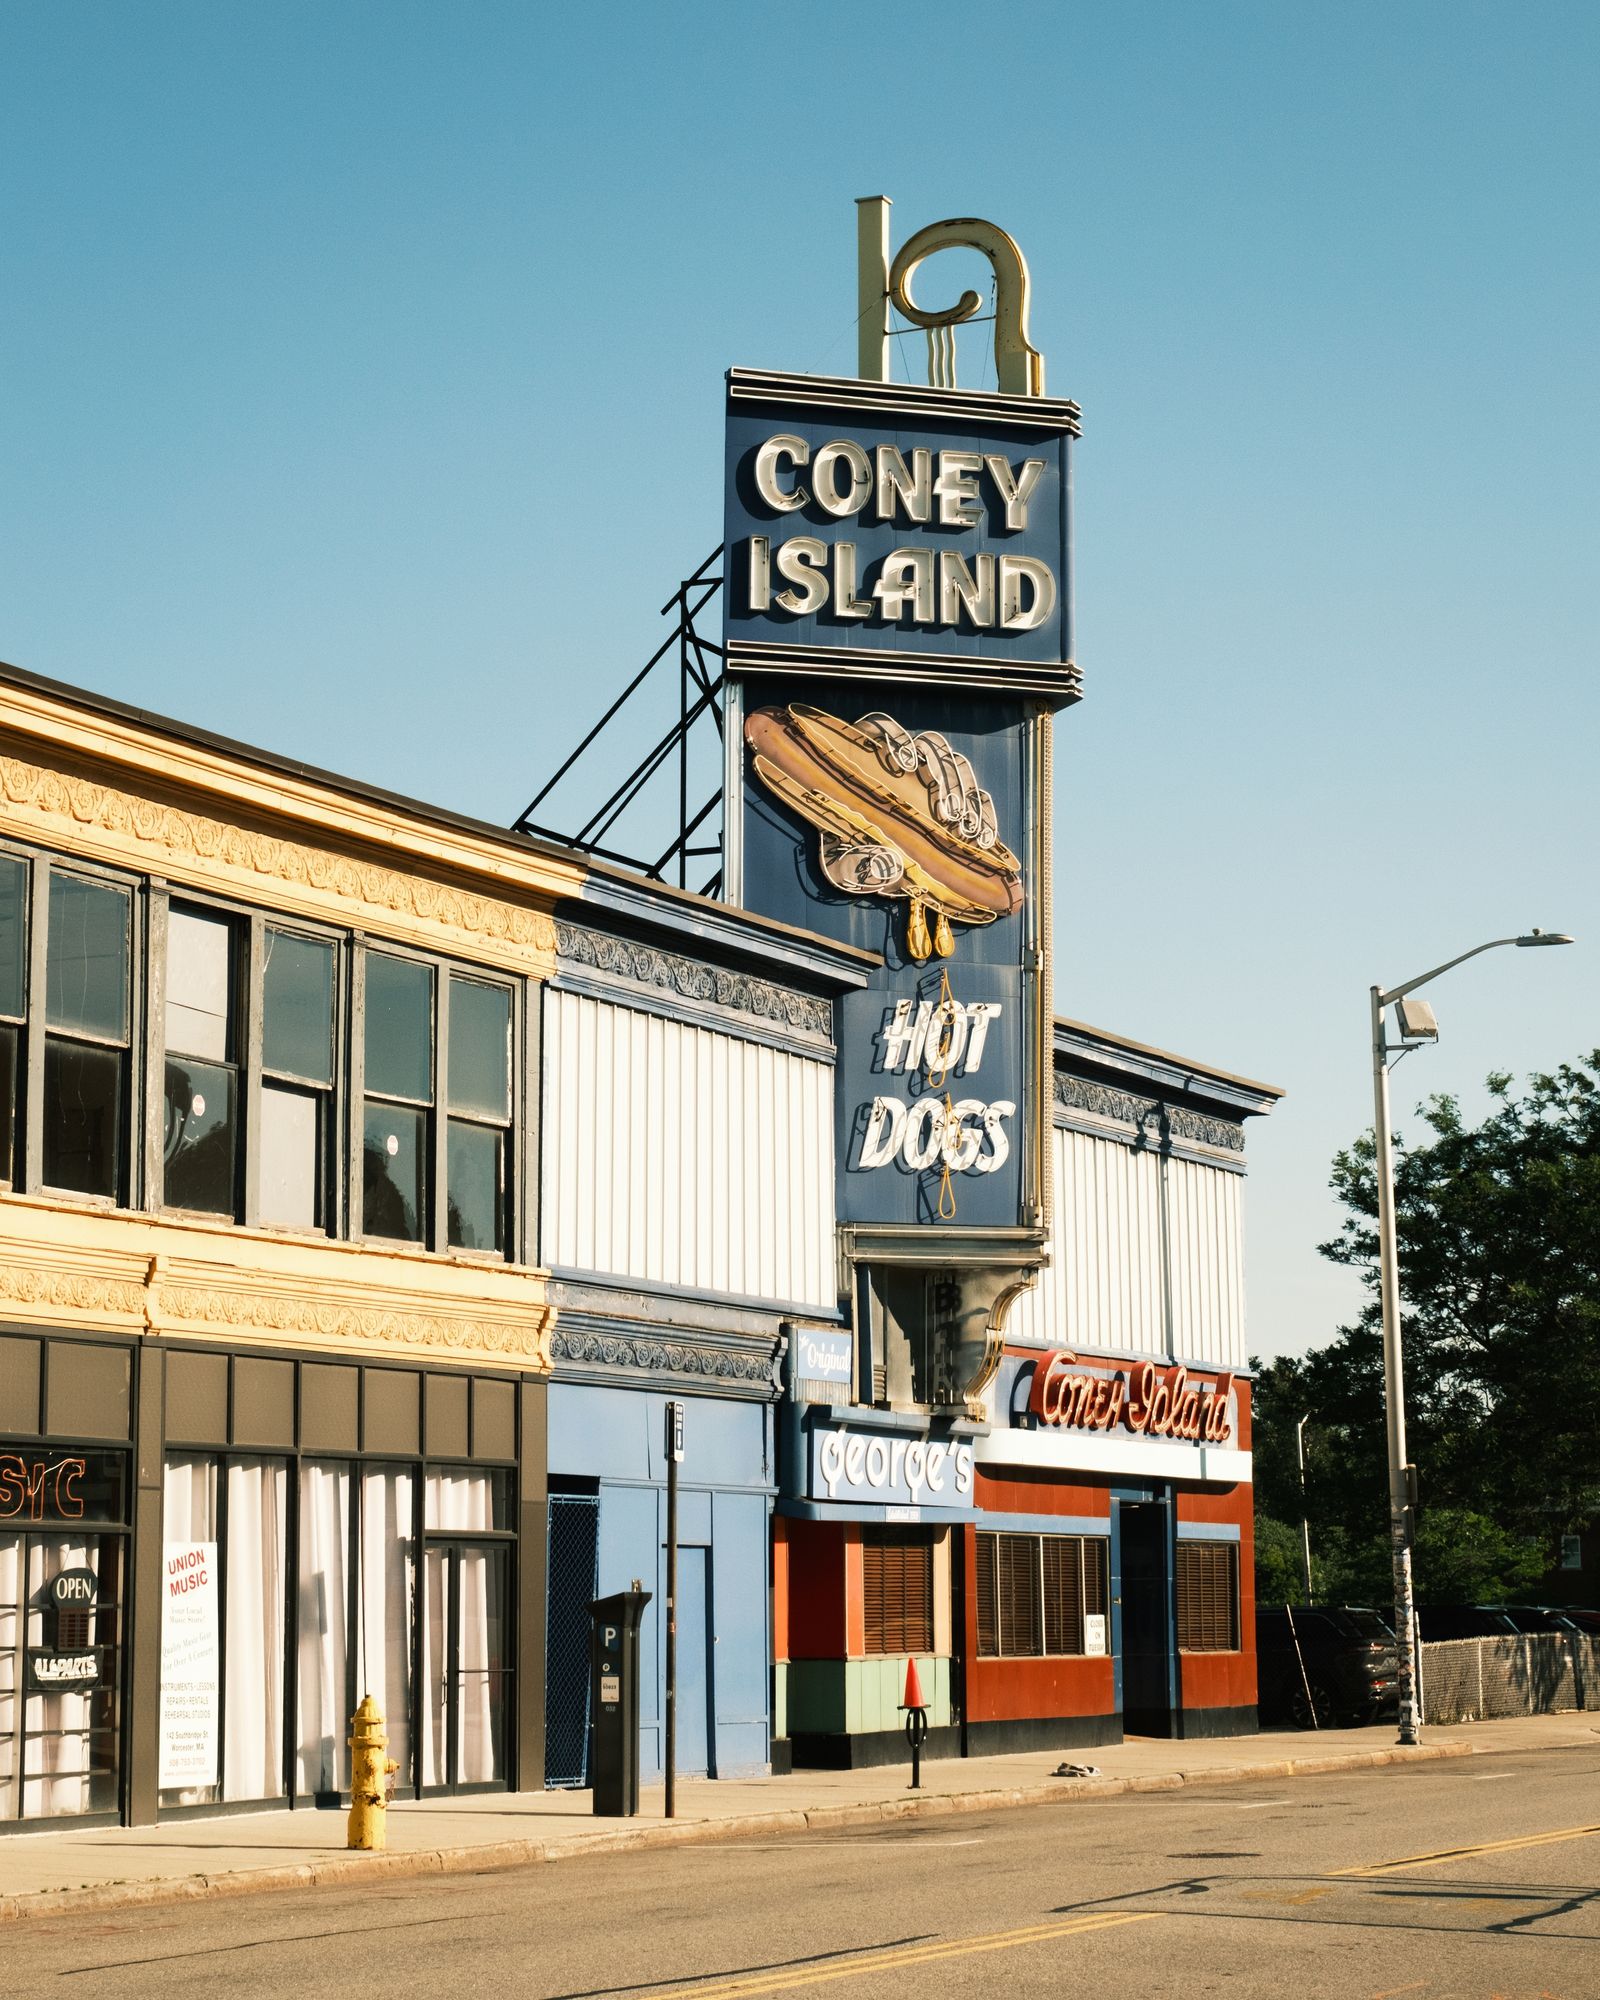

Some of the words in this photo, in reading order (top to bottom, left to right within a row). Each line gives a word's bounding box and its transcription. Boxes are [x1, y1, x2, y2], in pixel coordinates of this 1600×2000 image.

[755, 433, 1047, 531] CONEY
[750, 535, 1056, 630] ISLAND
[883, 999, 1002, 1073] HOT
[859, 1096, 1016, 1172] DOGS
[808, 1342, 851, 1377] Original
[1129, 1360, 1235, 1441] Island
[820, 1424, 972, 1503] george's
[56, 1577, 92, 1600] OPEN
[168, 1549, 205, 1575] UNION
[169, 1570, 208, 1597] MUSIC
[604, 1627, 616, 1647] P
